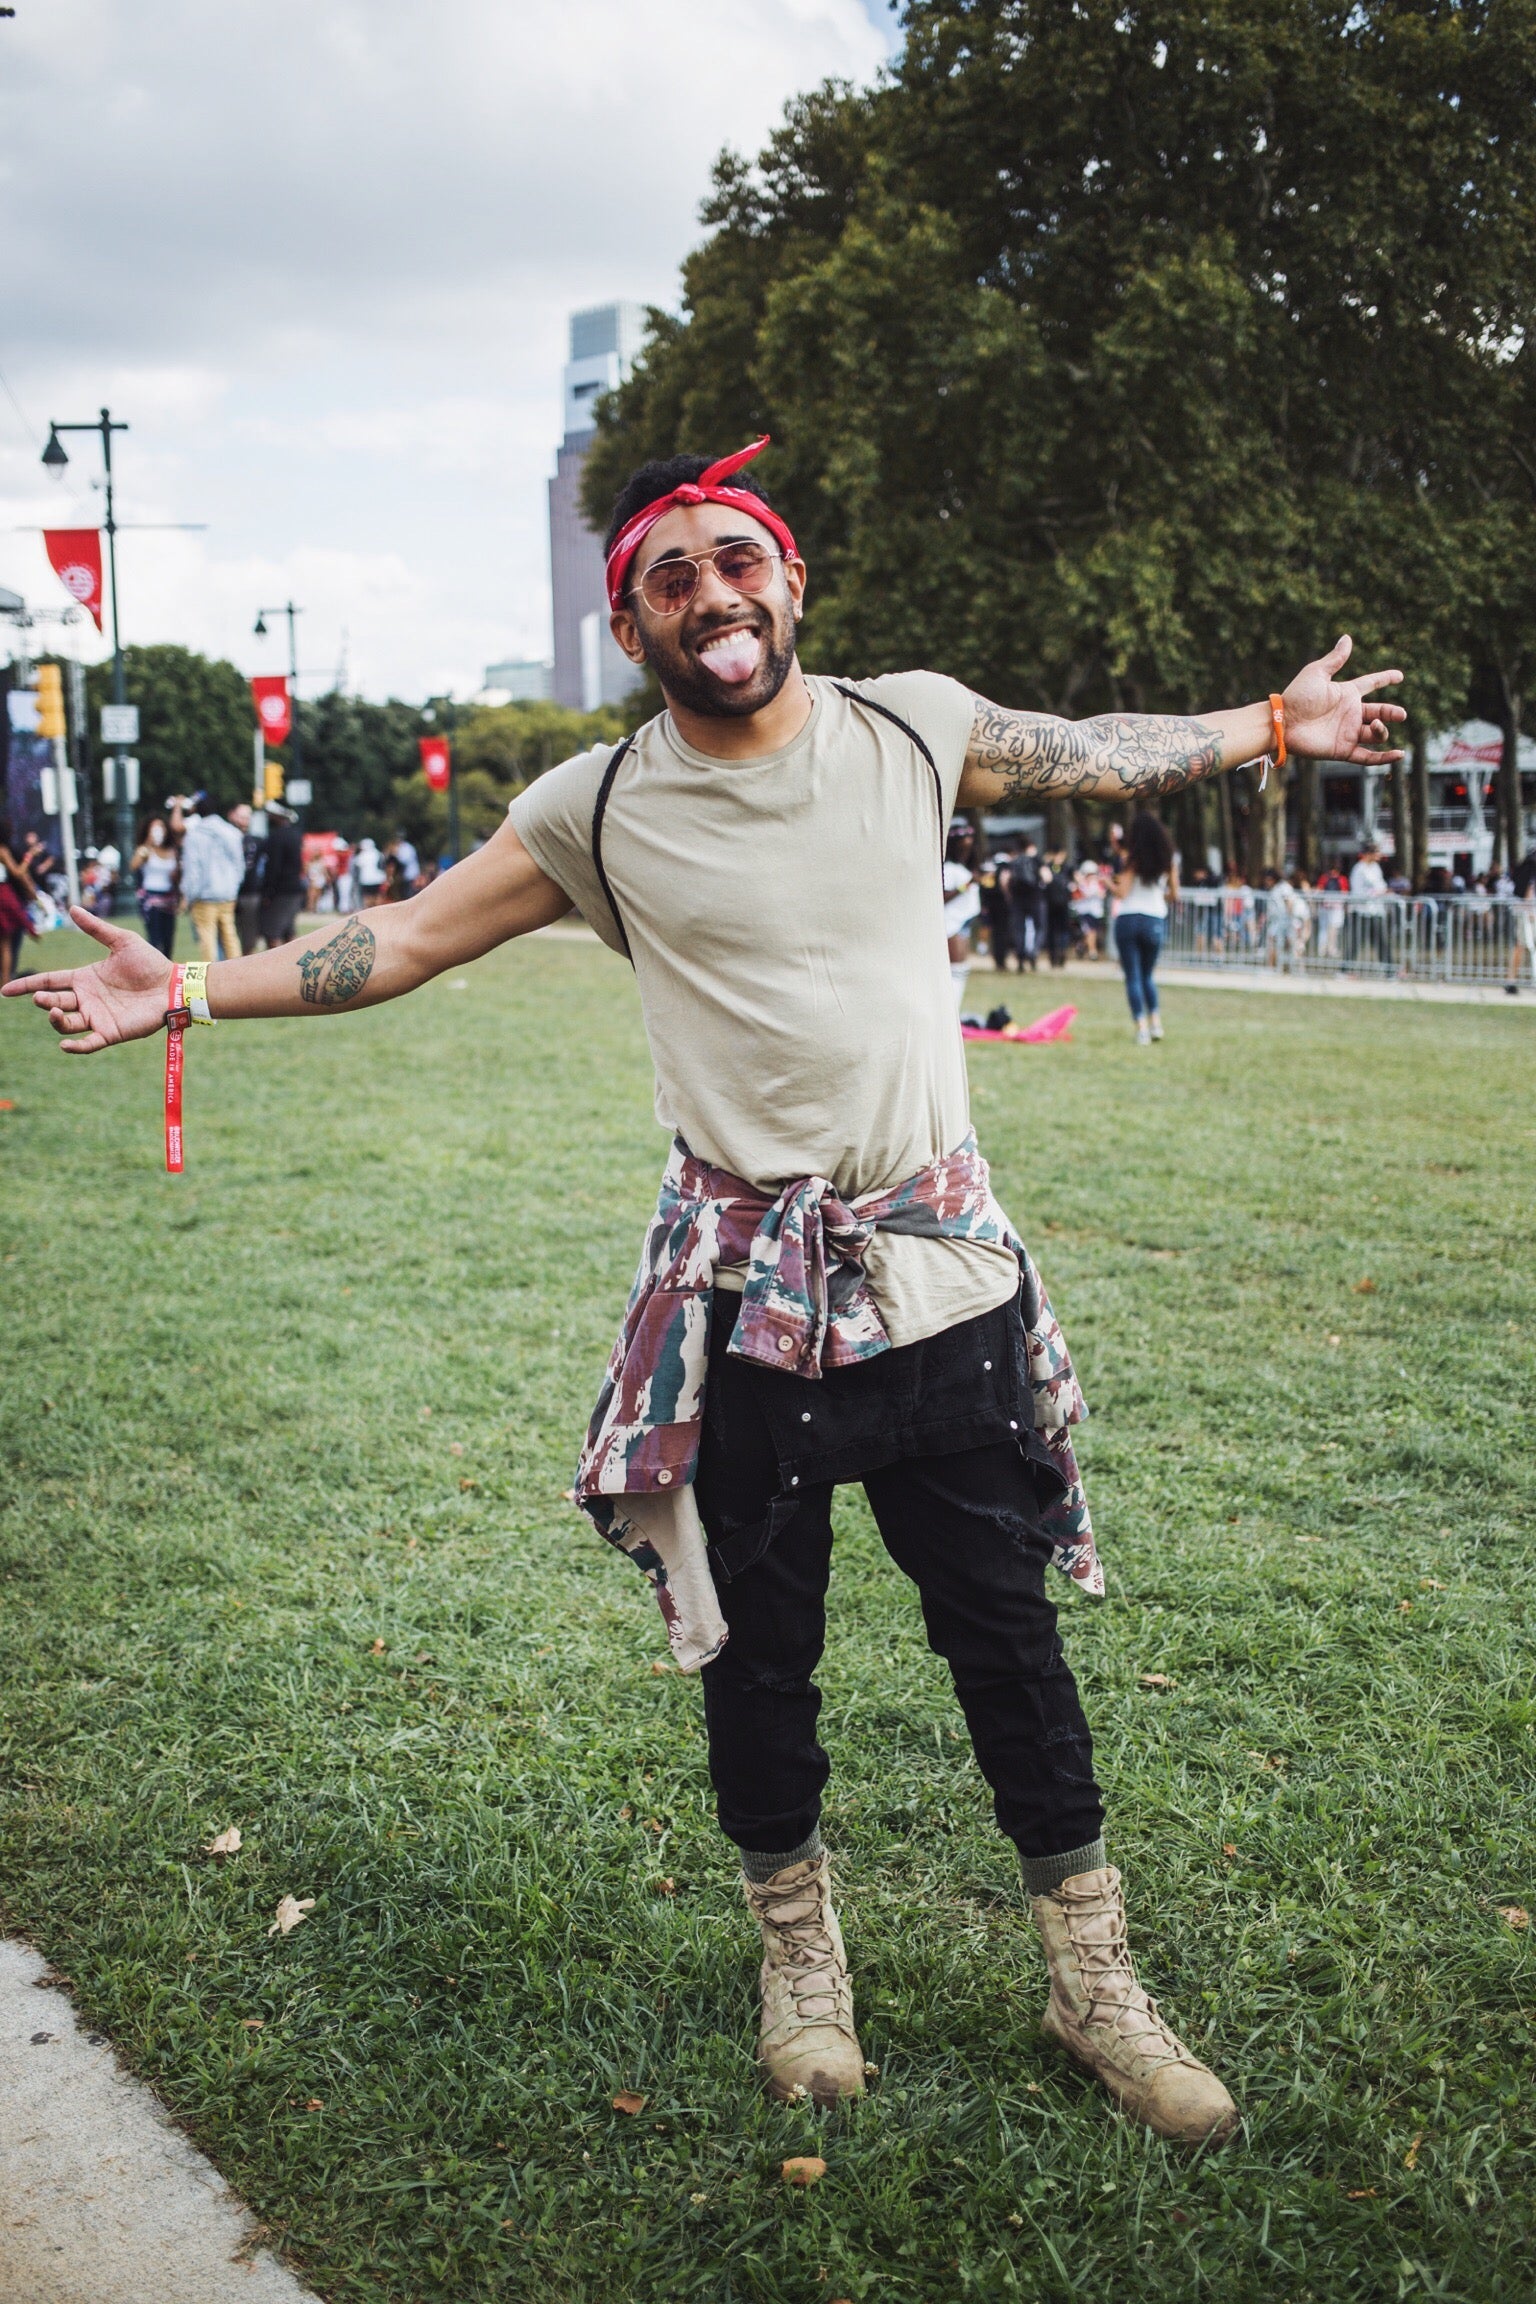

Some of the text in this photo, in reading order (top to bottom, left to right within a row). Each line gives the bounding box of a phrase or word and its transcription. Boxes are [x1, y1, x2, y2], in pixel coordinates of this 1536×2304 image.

[186, 966, 198, 980] 21
[329, 946, 361, 988] SOLDIER
[351, 976, 362, 990] OF
